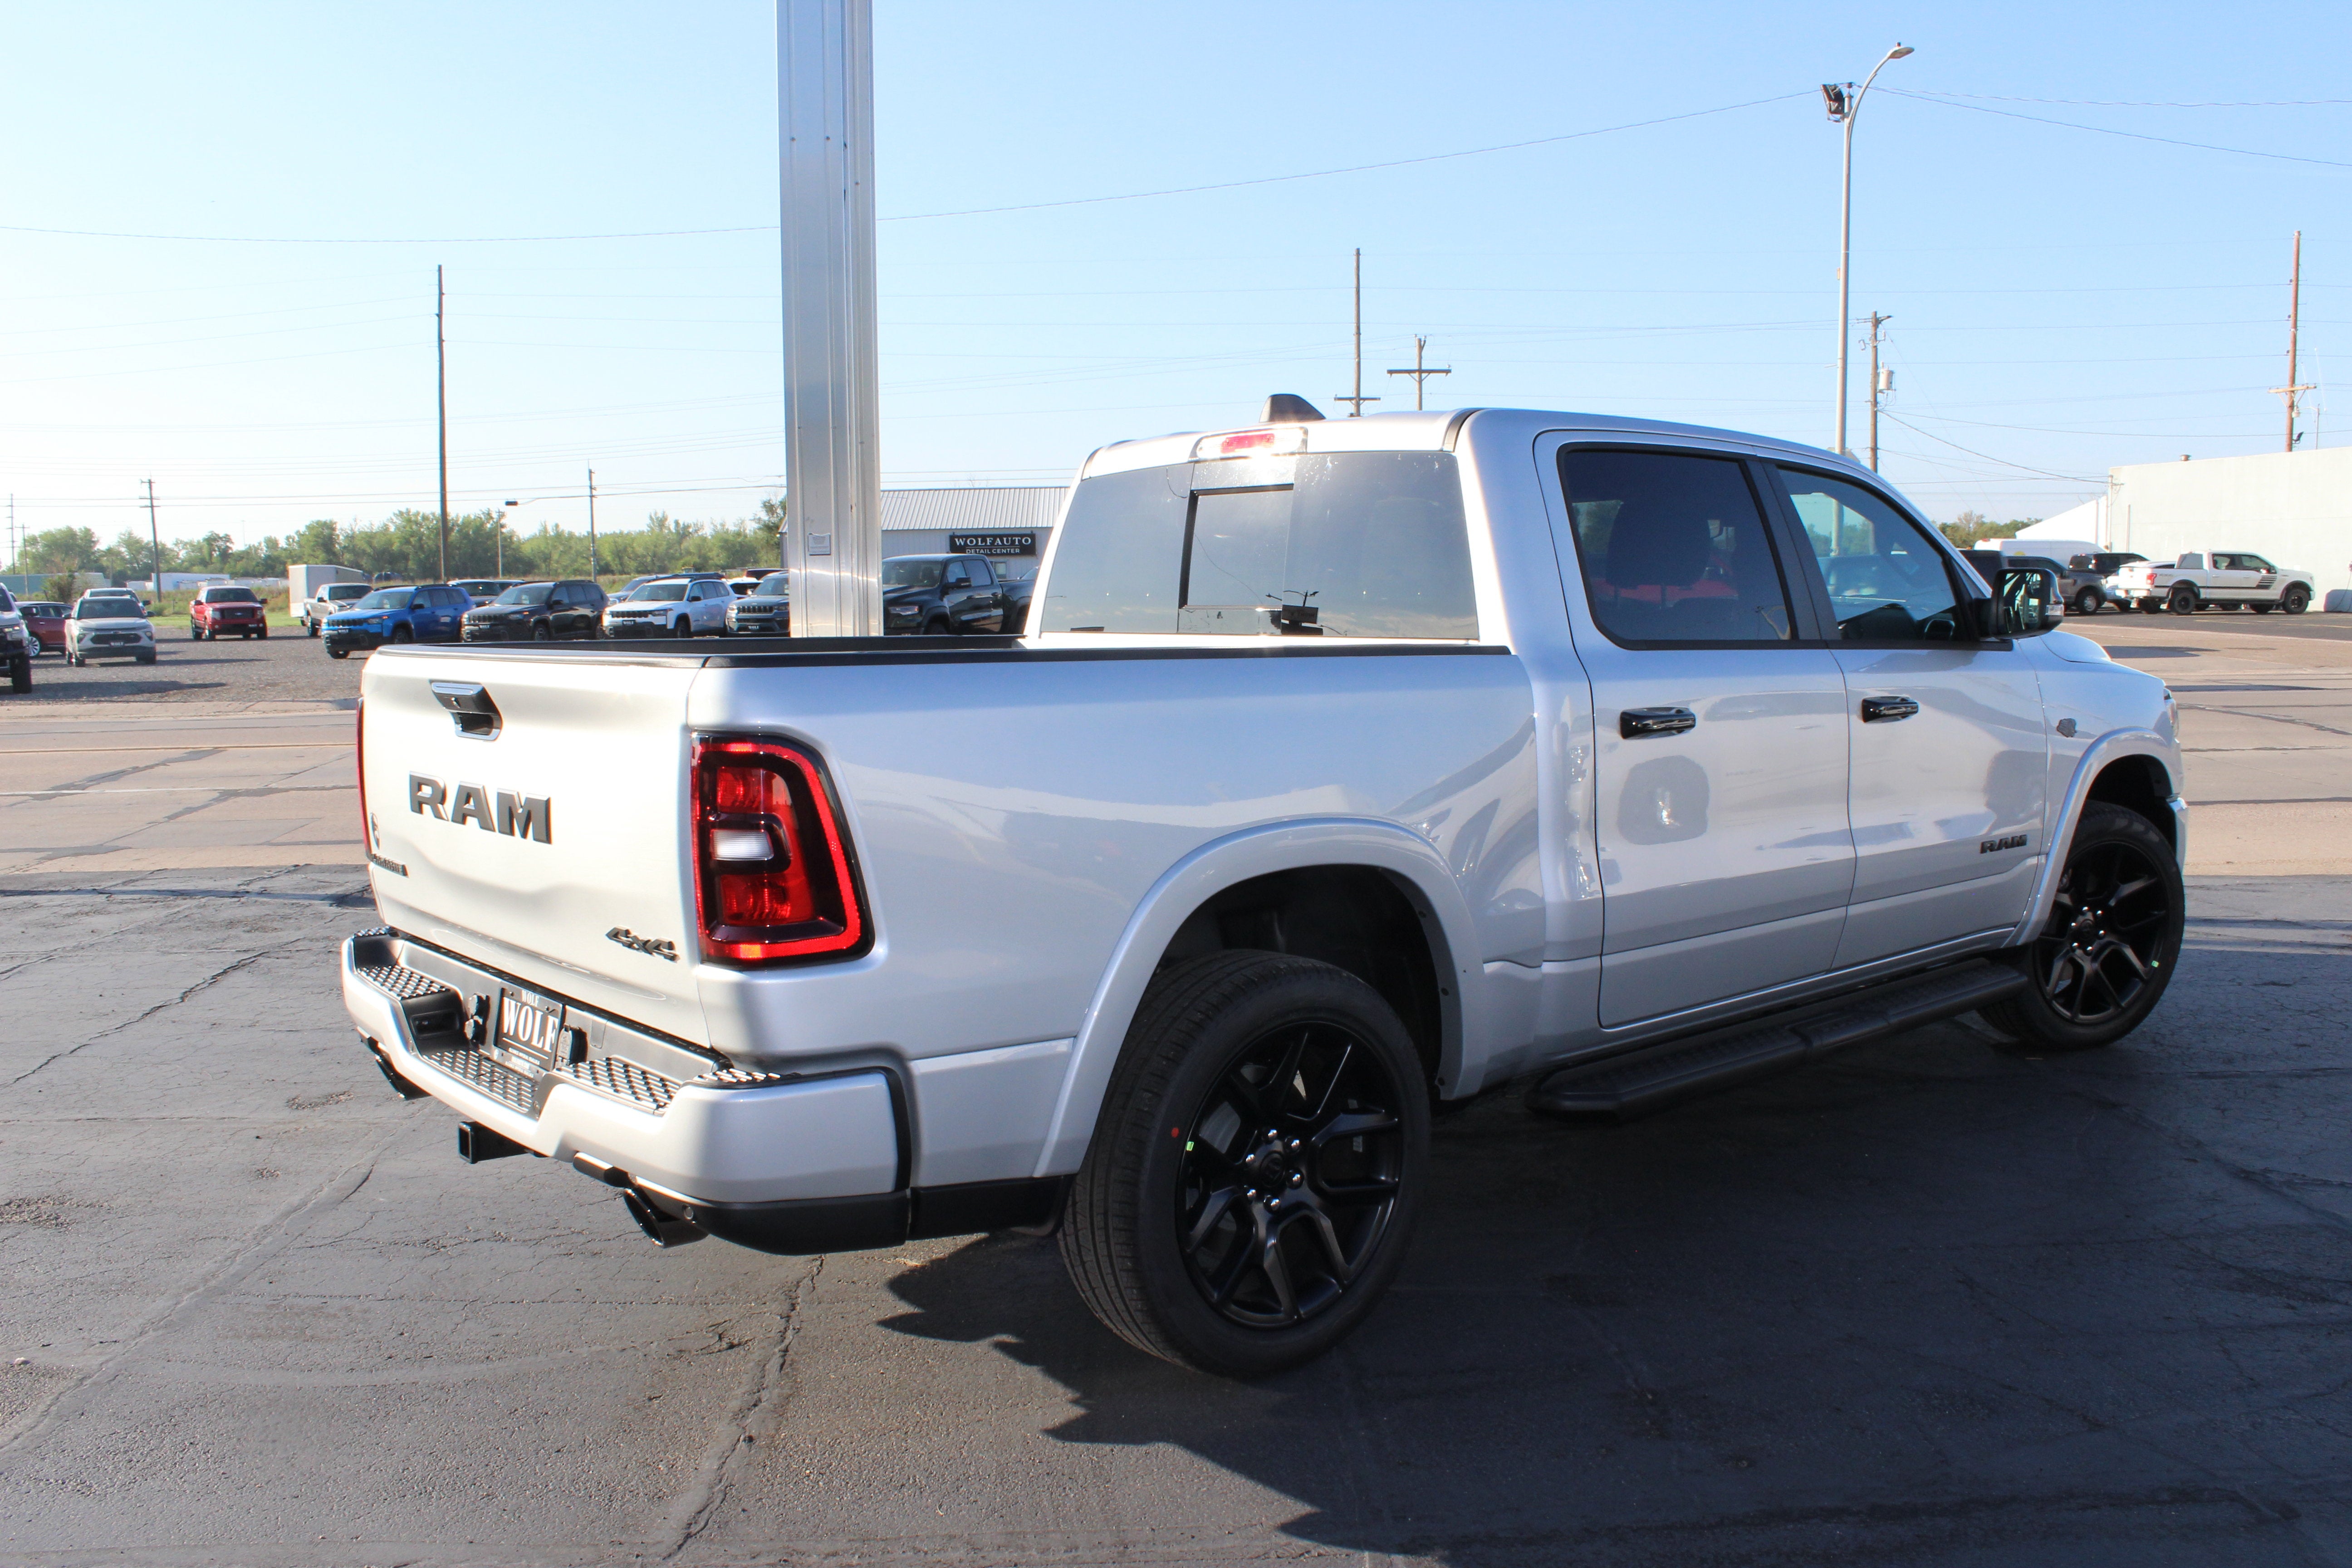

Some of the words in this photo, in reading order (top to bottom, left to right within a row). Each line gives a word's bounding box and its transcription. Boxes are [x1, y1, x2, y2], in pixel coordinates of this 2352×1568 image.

[955, 537, 1032, 546] WOLFAUTO
[409, 770, 553, 845] RAM
[1980, 834, 2027, 854] RAM
[521, 990, 540, 1007] WOLF
[502, 997, 559, 1053] WOLF
